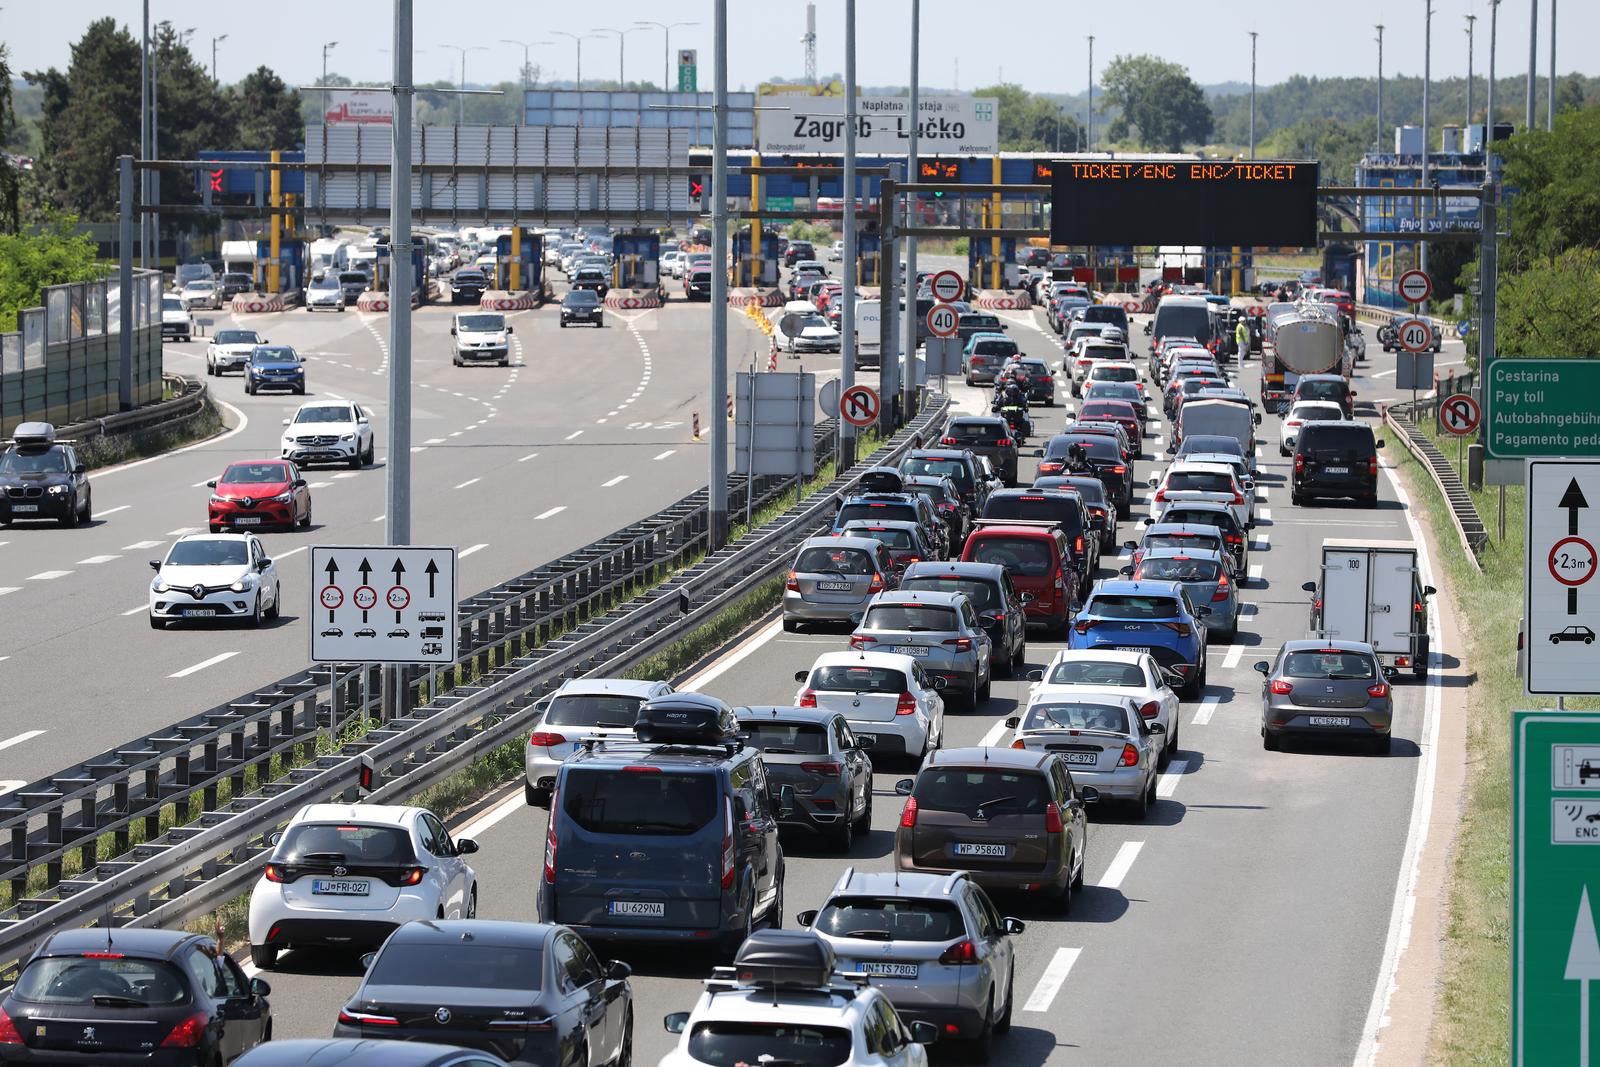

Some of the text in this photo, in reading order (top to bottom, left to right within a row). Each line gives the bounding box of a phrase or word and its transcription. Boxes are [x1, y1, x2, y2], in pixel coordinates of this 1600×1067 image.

[862, 101, 903, 112] Naplatna
[794, 116, 871, 142] Zagrb
[1072, 164, 1295, 180] TICKET/ENC ENC/TICKET
[934, 313, 953, 328] 40
[1406, 329, 1424, 345] 40
[1495, 369, 1559, 382] Cestarina
[1495, 390, 1544, 405] Pay toll
[1495, 432, 1569, 447] Pagamento
[1348, 560, 1359, 569] 100
[1575, 827, 1599, 838] ENC
[960, 844, 1004, 855] WP 9586N
[320, 882, 331, 891] LJ
[615, 903, 662, 914] LU 629NA
[862, 963, 916, 975] UN TS 7803
